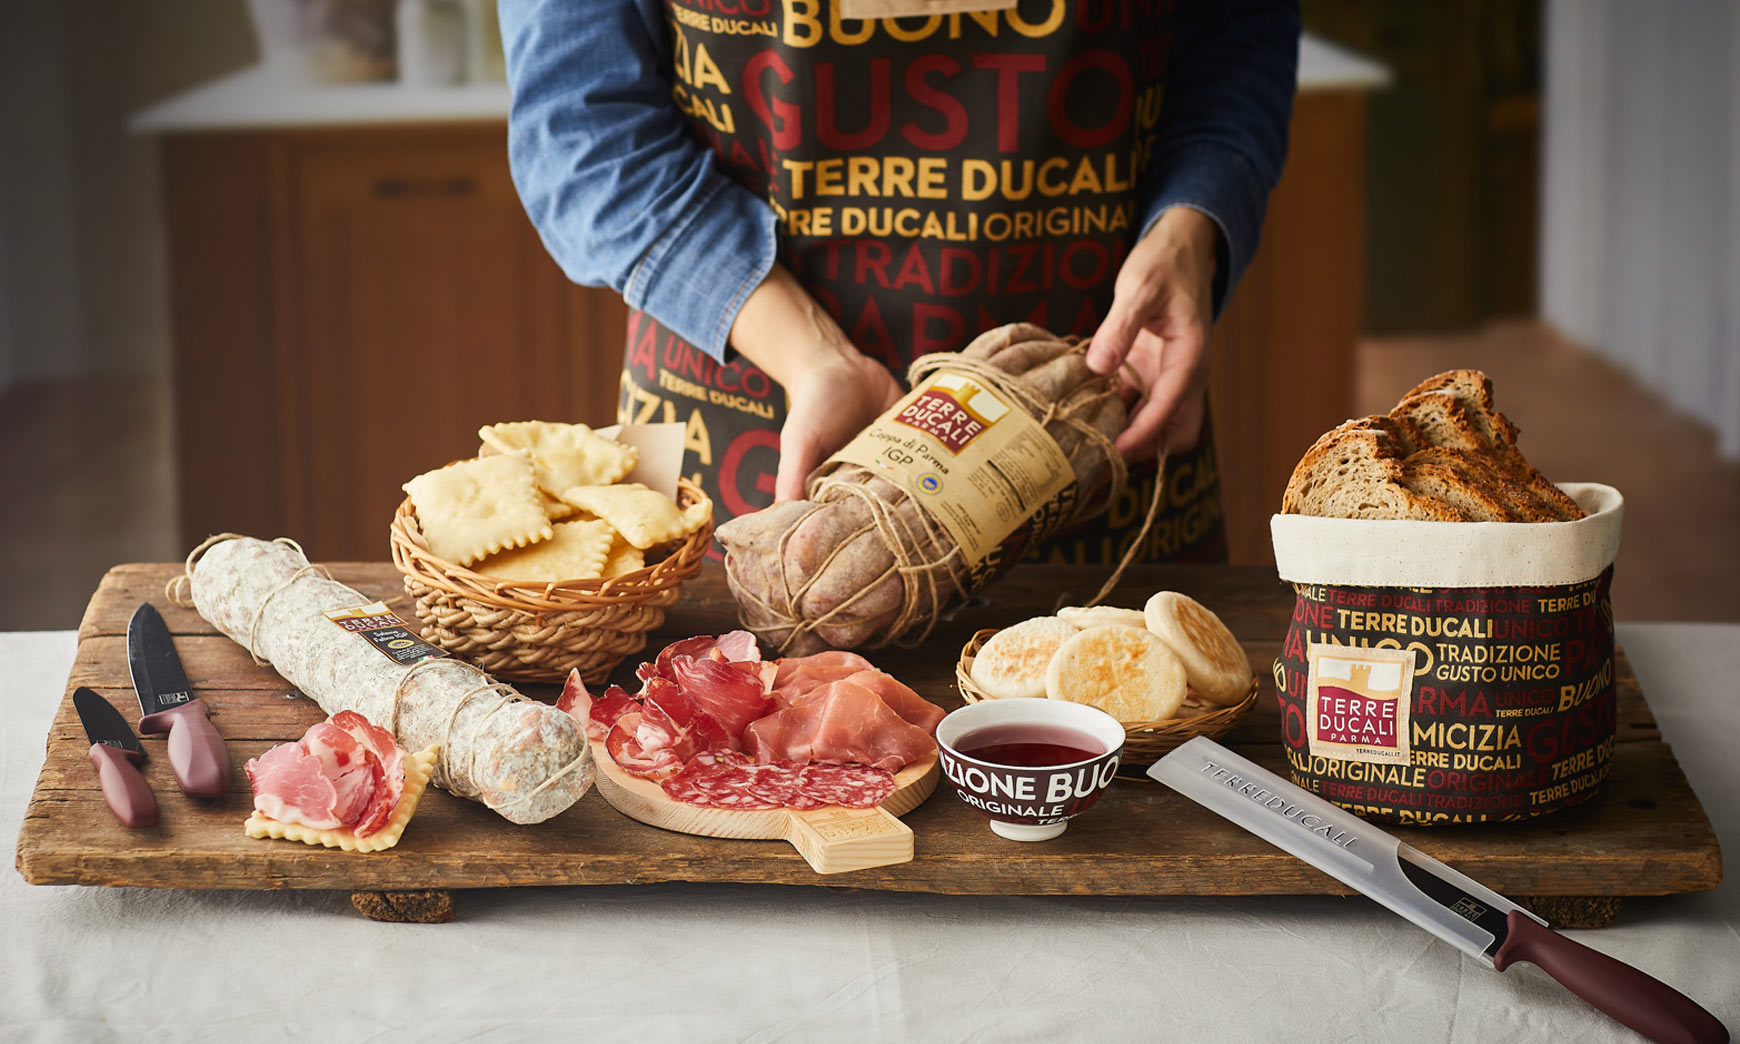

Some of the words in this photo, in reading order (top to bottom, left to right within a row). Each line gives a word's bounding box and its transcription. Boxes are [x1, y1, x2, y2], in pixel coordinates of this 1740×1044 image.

[711, 17, 778, 38] DUCALI
[742, 48, 1135, 153] GUSTO
[782, 158, 947, 200] TERRE
[961, 153, 1140, 201] DUCALI
[840, 207, 978, 241] DUCALI
[659, 368, 708, 403] TERRE
[708, 390, 775, 420] DUCALI
[902, 405, 971, 445] DUCALI
[917, 395, 982, 436] TERRE
[869, 428, 901, 443] Coppa
[903, 438, 916, 450] di
[915, 444, 949, 475] Parma
[882, 446, 914, 465] IGP
[1328, 587, 1377, 608] TERRE
[1380, 593, 1431, 614] DUCALI
[1435, 598, 1531, 615] TRADIZIONE
[1537, 595, 1580, 614] TERRE
[1337, 608, 1408, 634] TERRE
[1411, 616, 1493, 639] DUCALI
[1494, 616, 1568, 640] UNICO
[1436, 643, 1560, 664] TRADIZIONE
[1436, 664, 1497, 683] GUSTO
[1501, 664, 1560, 681] UNICO
[1558, 656, 1612, 712] BUONO
[1321, 696, 1394, 719] TERRE
[1411, 686, 1493, 719] RMA
[1496, 687, 1555, 708] UNICO
[1496, 709, 1523, 718] TERRE
[1525, 706, 1554, 716] DUCALI
[1320, 713, 1393, 736] DUCALI
[1330, 733, 1382, 745] PARMA
[1411, 720, 1522, 751] MICIZIA
[1313, 757, 1427, 788] ORIGINALE
[1427, 766, 1547, 791] ORIGINALE
[1453, 752, 1521, 771] DUCALI
[1551, 748, 1595, 782] TERRE
[957, 788, 1064, 818] ORIGINALE
[1200, 760, 1358, 850] TERREDUCALI
[1321, 780, 1363, 800] TERRE
[1366, 786, 1422, 806] DUCALI
[1425, 790, 1523, 811] TRADIZIONE
[1529, 778, 1570, 806] TERRE
